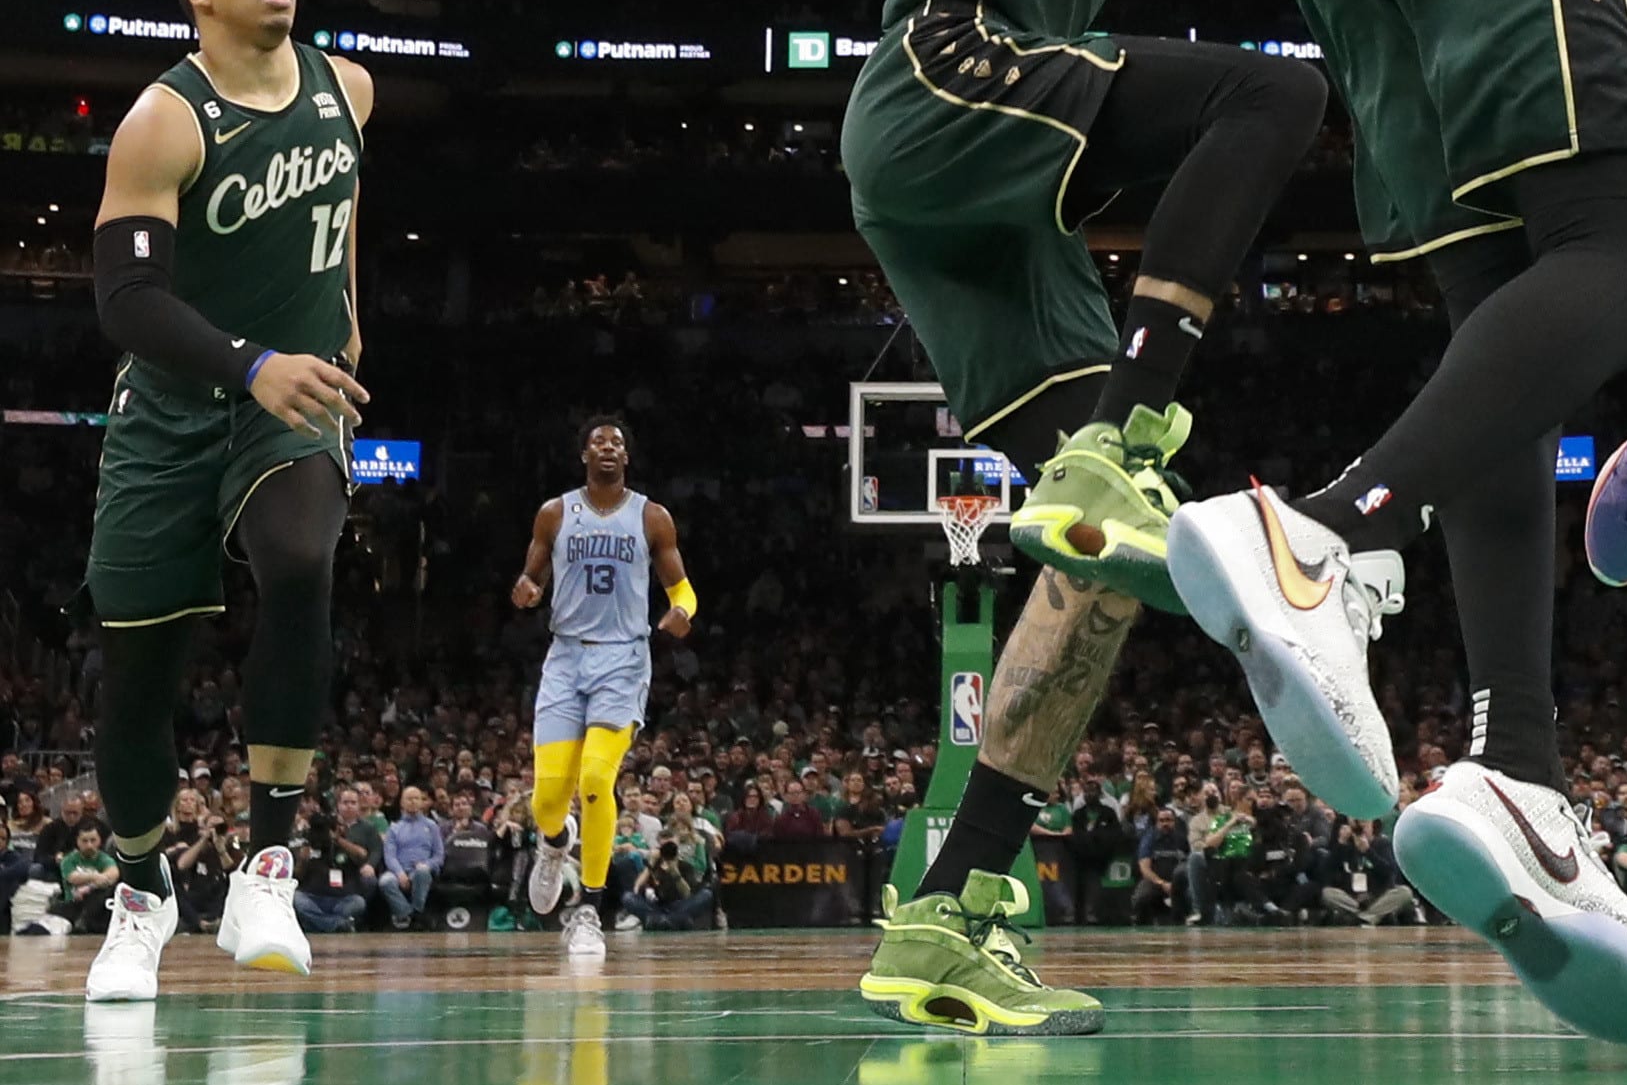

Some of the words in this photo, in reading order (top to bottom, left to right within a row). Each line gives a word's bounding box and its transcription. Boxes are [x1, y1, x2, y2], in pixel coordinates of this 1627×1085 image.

[108, 16, 191, 39] Putnam
[356, 33, 435, 56] Putnam
[598, 41, 677, 59] Putnam
[793, 38, 825, 61] TD
[203, 101, 221, 119] 6
[206, 138, 355, 235] Celtics
[311, 199, 352, 273] 12
[567, 535, 636, 564] GRIZZLIES
[583, 564, 615, 595] 13
[720, 863, 847, 884] GARDEN
